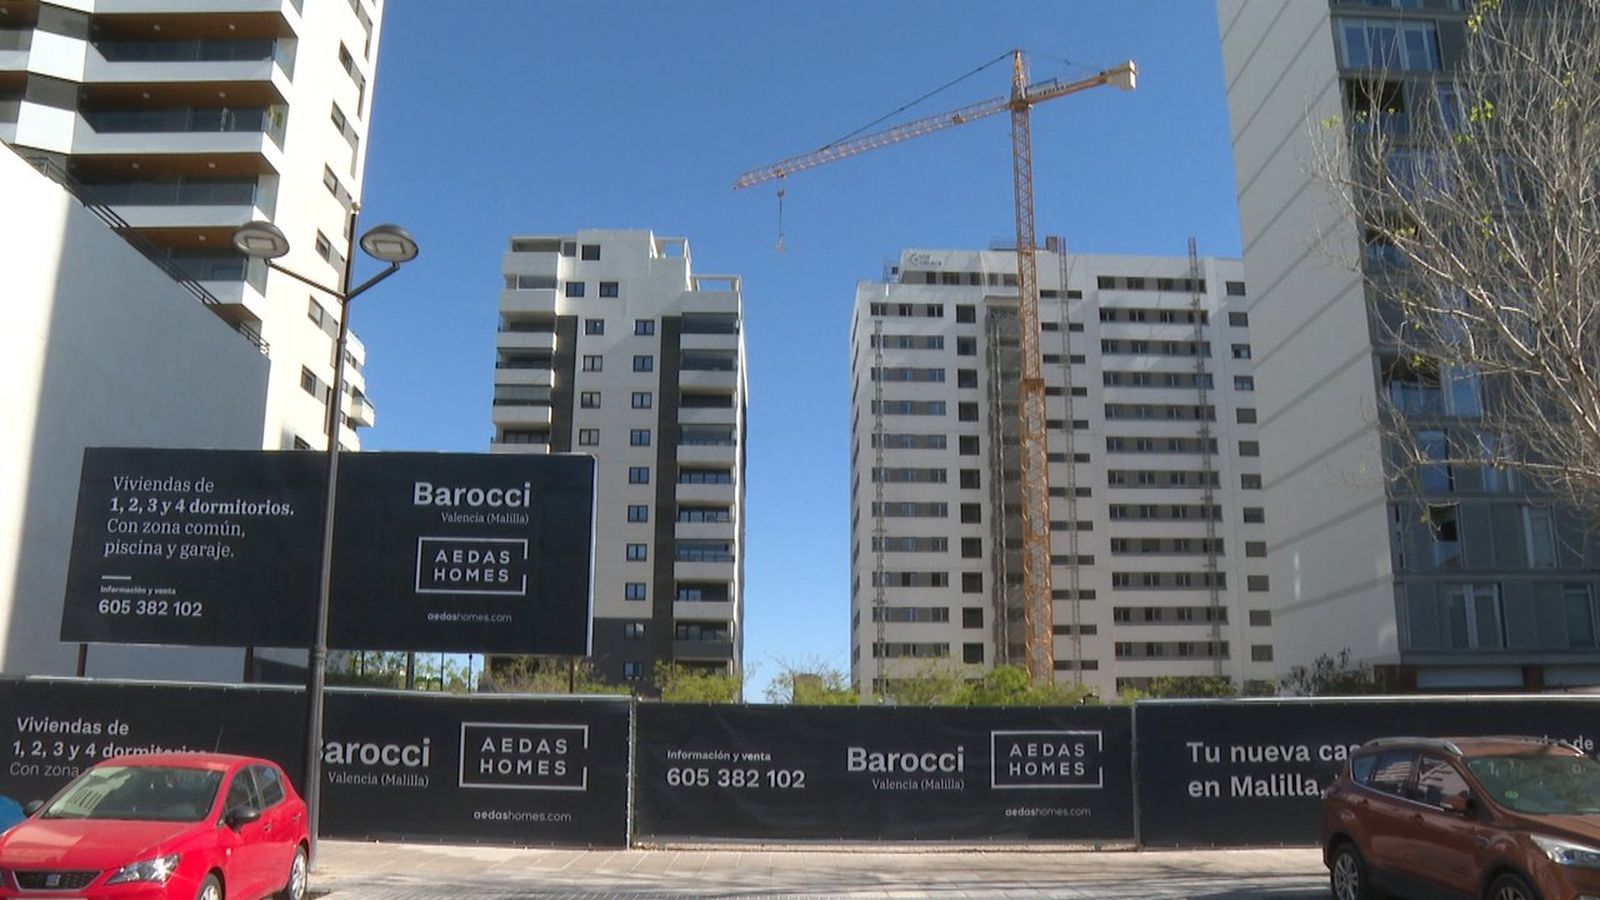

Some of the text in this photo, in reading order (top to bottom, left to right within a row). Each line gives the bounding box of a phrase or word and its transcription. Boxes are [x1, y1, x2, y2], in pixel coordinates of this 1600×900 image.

[113, 475, 215, 493] Viviendas de
[413, 481, 532, 508] Barocci
[109, 497, 295, 517] 1, 2, 3 y 4 dormitorios.
[441, 511, 530, 525] Valencia (Malilla)
[106, 517, 246, 538] Con zona común,
[103, 538, 235, 561] piscina y garaje.
[434, 549, 511, 565] AEDAS
[433, 567, 510, 583] HOMES
[99, 584, 147, 594] Información
[154, 587, 177, 596] venta
[97, 598, 203, 617] 605 382 102
[427, 610, 512, 623] aedashomes.com
[16, 716, 130, 736] Viviendas de
[12, 740, 25, 758] 1,
[31, 740, 47, 759] 2,
[52, 741, 64, 757] 3
[67, 744, 81, 761] y
[84, 742, 97, 759] 4
[480, 737, 568, 755] AEDAS
[1009, 742, 1086, 758] AEDAS
[1572, 734, 1595, 751] de
[320, 737, 431, 768] arocci
[666, 748, 772, 764] Información y venta
[846, 745, 964, 773] Barocci
[1185, 741, 1221, 763] Tu
[1230, 744, 1311, 763] nueva
[9, 761, 80, 777] Con zona
[479, 758, 567, 776] HOMES
[1009, 761, 1086, 777] HOMES
[327, 771, 429, 788] Valencia (Malilla)
[666, 767, 806, 789] 605 382 102
[871, 777, 965, 792] Valencia (Malilla)
[1187, 773, 1325, 800] en Malilla,
[473, 809, 572, 823] aedashomes.com
[1004, 806, 1092, 818] aedashomes.com
